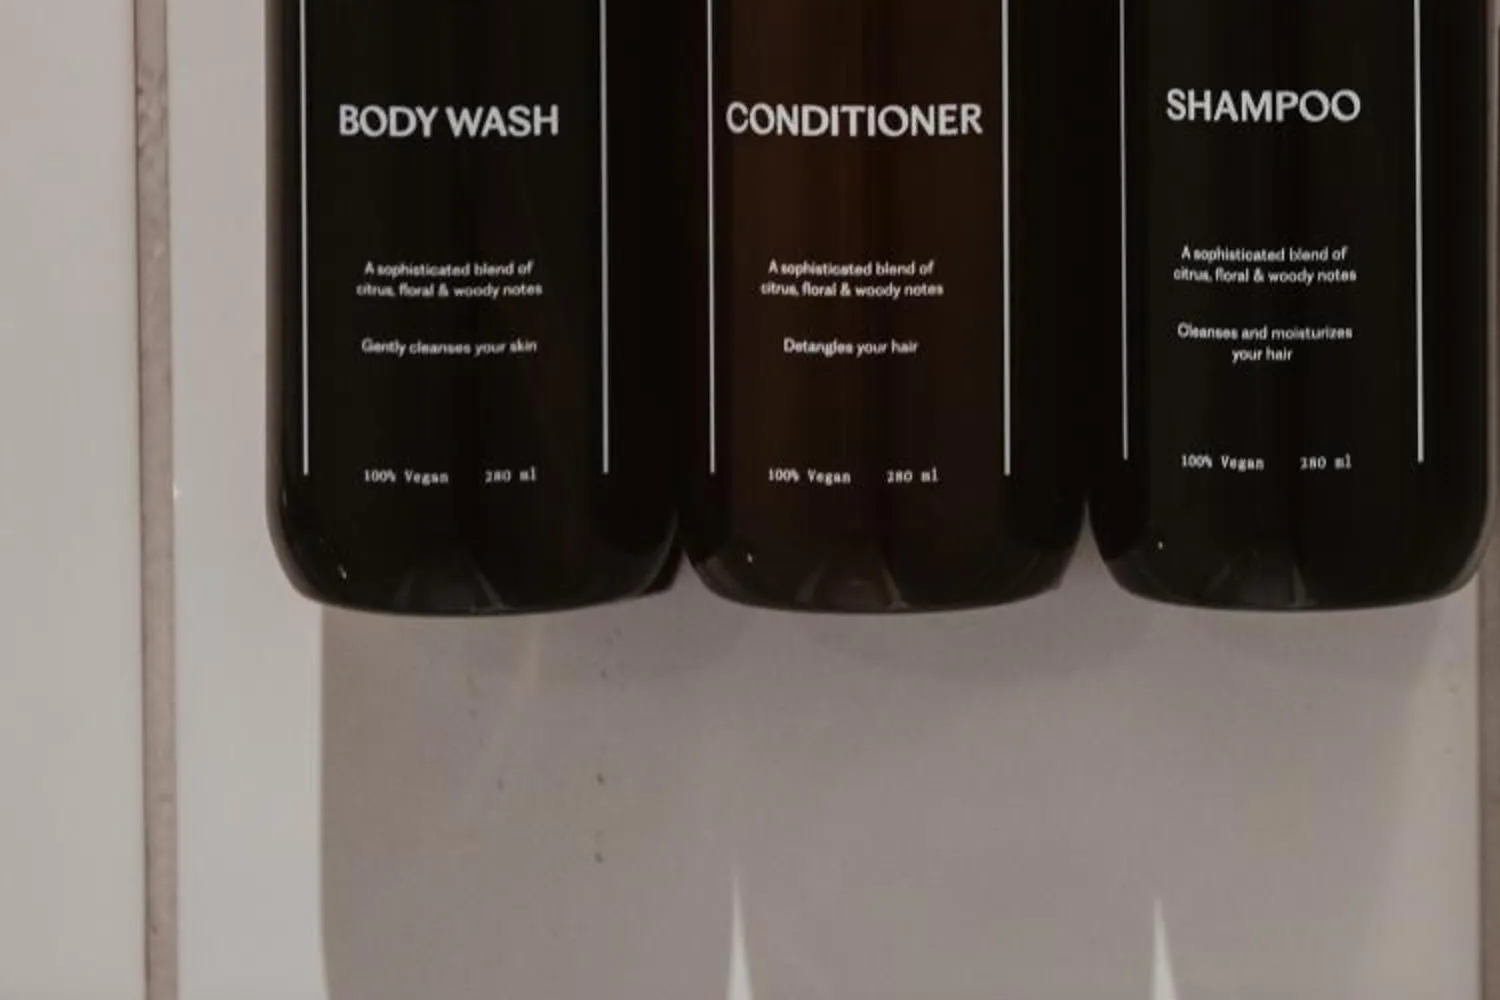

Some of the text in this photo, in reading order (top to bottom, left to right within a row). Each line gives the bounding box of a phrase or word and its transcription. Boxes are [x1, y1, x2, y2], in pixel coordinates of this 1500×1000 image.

[1165, 87, 1362, 123] SHAMPOO
[338, 103, 559, 138] BODY WASH
[725, 100, 984, 138] CONDITIONER
[1180, 244, 1349, 264] A sophisticated blend of
[364, 260, 534, 279] A sophisticated blend of
[767, 258, 935, 279] A sophisticated blend of
[1214, 266, 1250, 283] floral
[1252, 267, 1265, 283] &
[1267, 267, 1315, 286] woody
[1317, 268, 1357, 283] notes
[398, 282, 435, 297] floral
[437, 282, 450, 298] &
[453, 282, 501, 300] woody
[502, 283, 543, 297] notes
[801, 279, 838, 297] floral
[839, 281, 852, 297] &
[854, 281, 902, 301] woody
[903, 282, 945, 297] notes
[1177, 321, 1353, 341] Cleanses and moisturizes
[361, 337, 538, 358] Gently cleanses your skin
[783, 336, 919, 358] Detangles your hair
[1231, 346, 1293, 364] your hair
[1181, 453, 1213, 469] 100%
[1220, 455, 1265, 473] Vegan
[1334, 453, 1352, 470] ml
[364, 469, 397, 483] 100%
[404, 469, 449, 486] Vegan
[519, 466, 537, 482] ml
[768, 467, 801, 483] 100%
[807, 468, 852, 487] Vegan
[920, 466, 938, 483] ml
